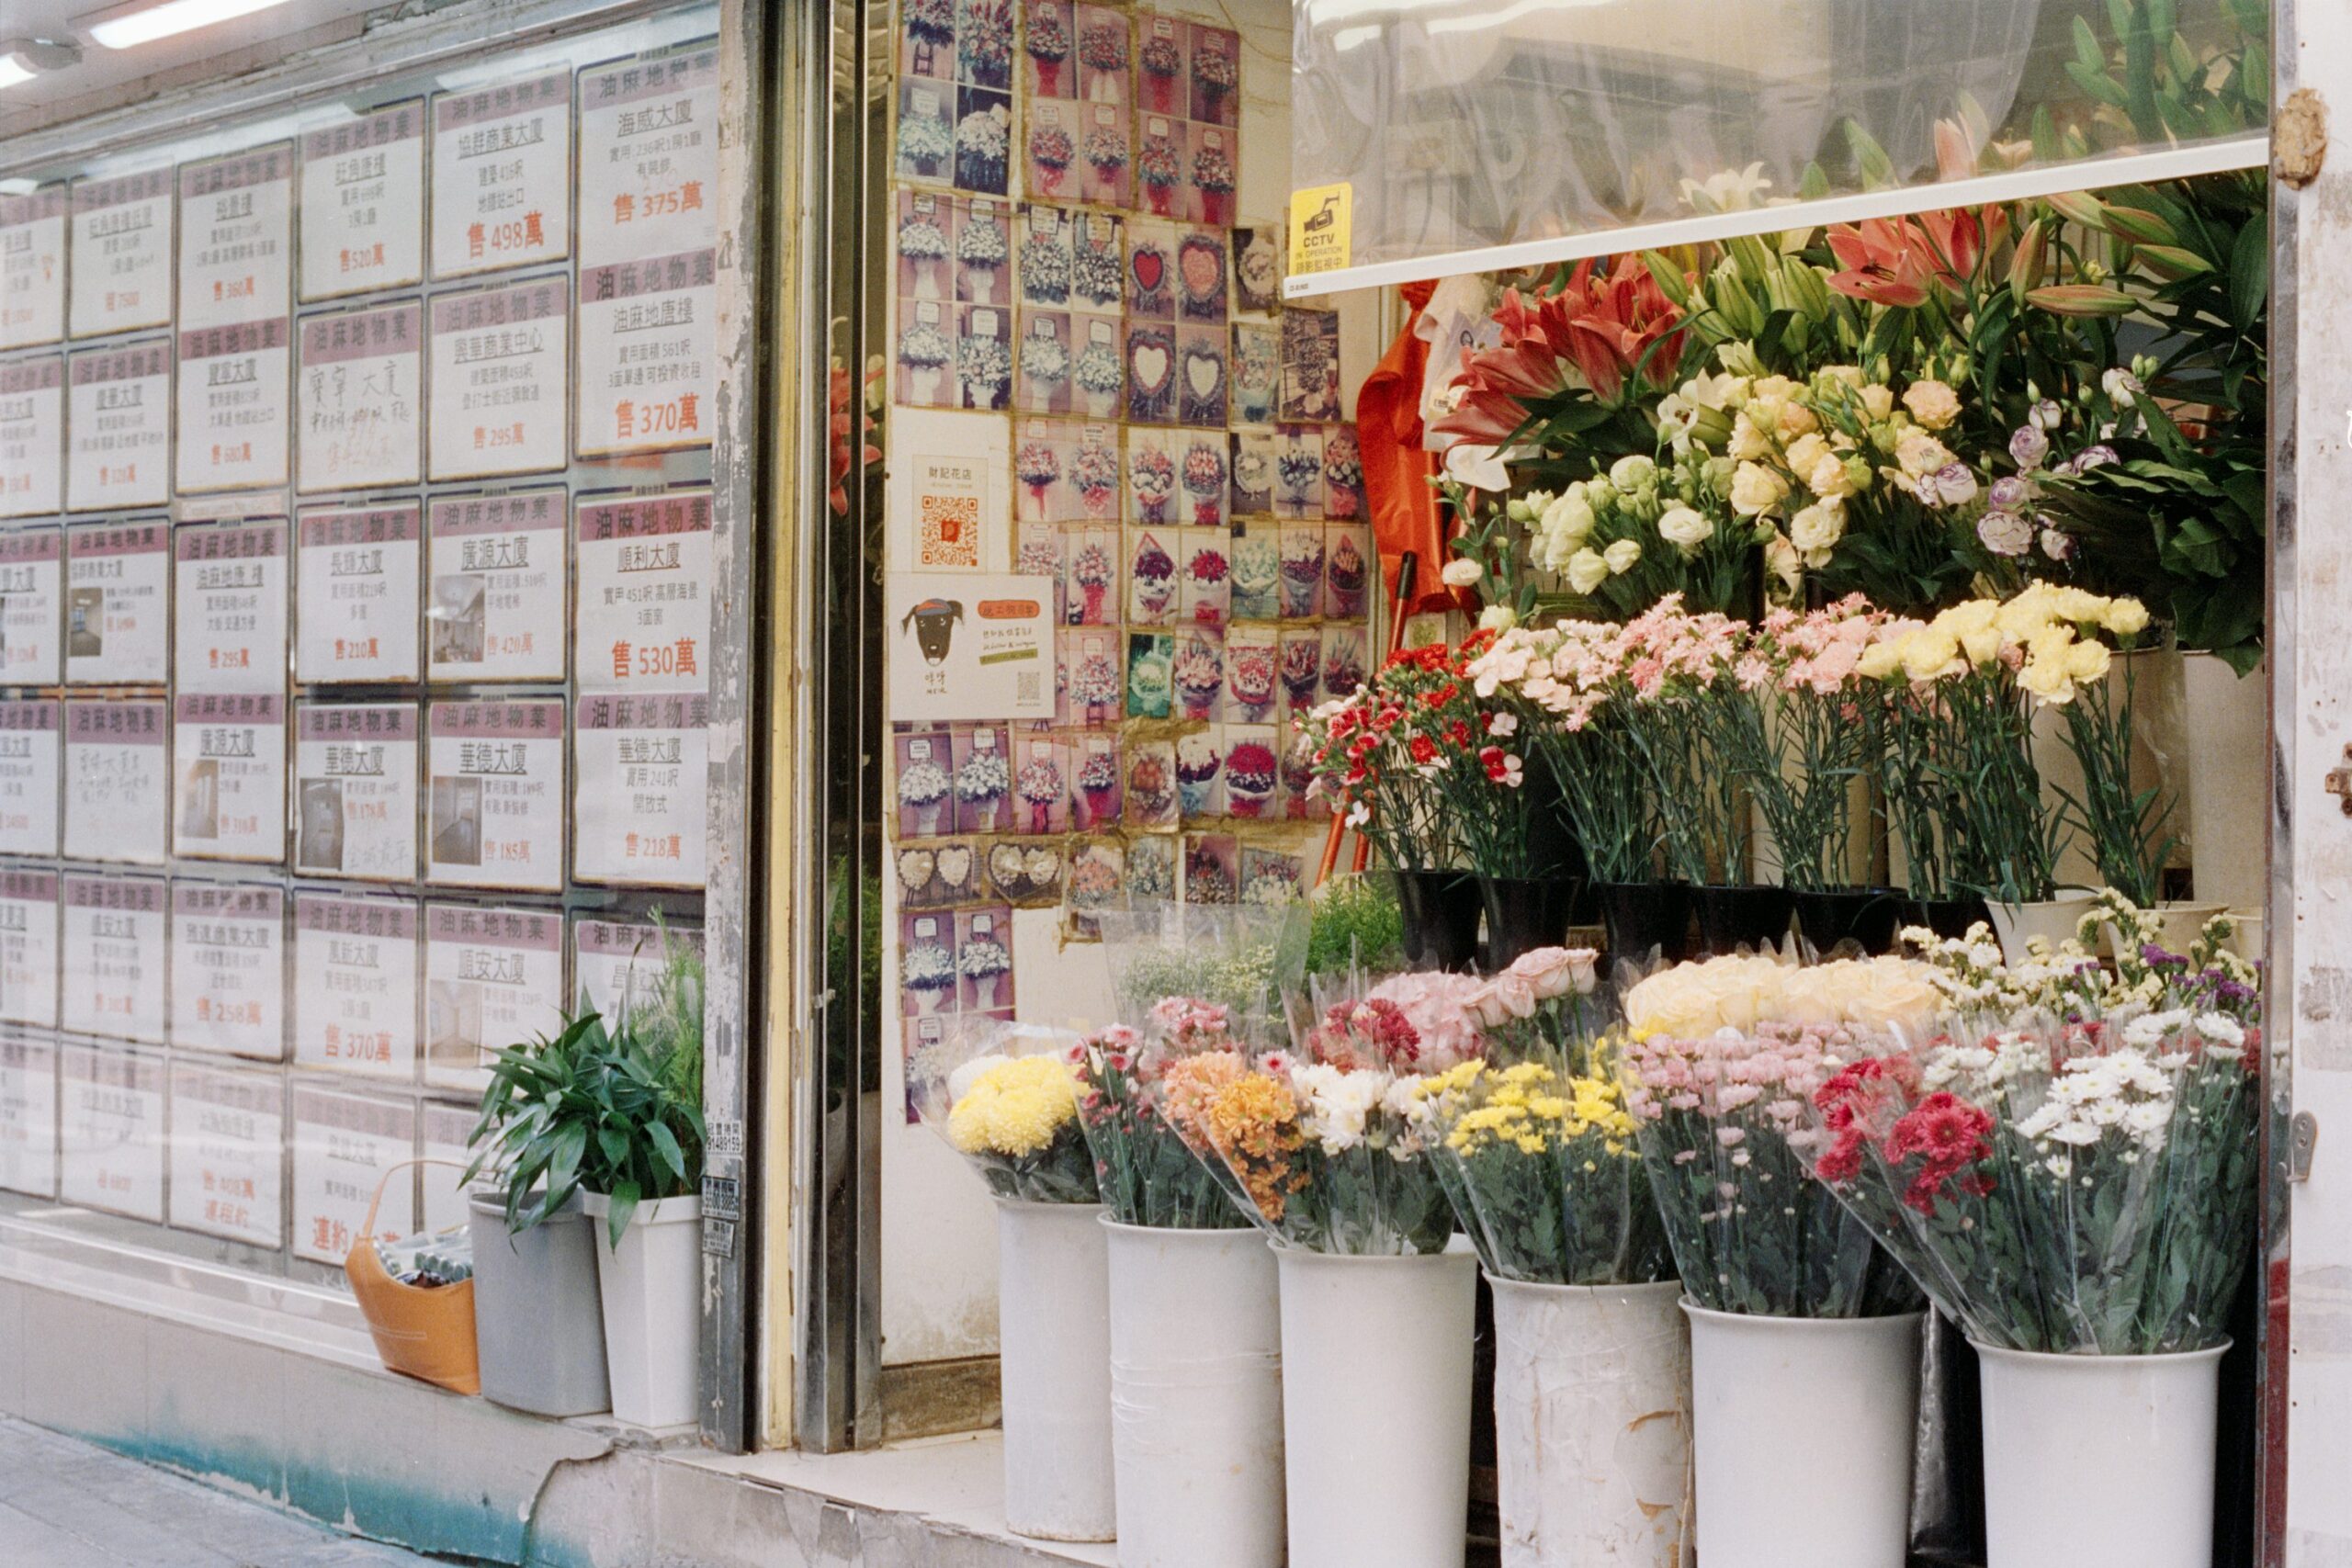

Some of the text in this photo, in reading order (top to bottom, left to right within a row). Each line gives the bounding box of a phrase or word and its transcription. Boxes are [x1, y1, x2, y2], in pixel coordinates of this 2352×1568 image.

[1303, 233, 1334, 248] CCTV
[1306, 245, 1342, 259] OPERATION
[597, 251, 713, 299] 油麻地物業
[447, 287, 551, 333] 油麻地物業
[614, 298, 694, 332] 油麻地唐樓
[444, 496, 549, 526] 油麻地物業
[596, 497, 707, 539] 油麻地物業
[189, 529, 275, 560] 油麻地物業
[311, 513, 407, 545] 油麻地物業
[462, 535, 529, 569] 廣源大廈
[618, 542, 681, 570] 順利大廈
[186, 696, 272, 716] 油麻地物業
[311, 710, 401, 732] 油麻地物業
[443, 705, 546, 729] 油麻地物業
[591, 696, 707, 728] 油麻地物業
[326, 745, 385, 773] 華德大廈
[460, 742, 527, 773] 華德大廈
[618, 737, 682, 762] 華德大廈
[310, 905, 402, 938] 油麻地物業
[440, 910, 545, 942] 油麻地物業
